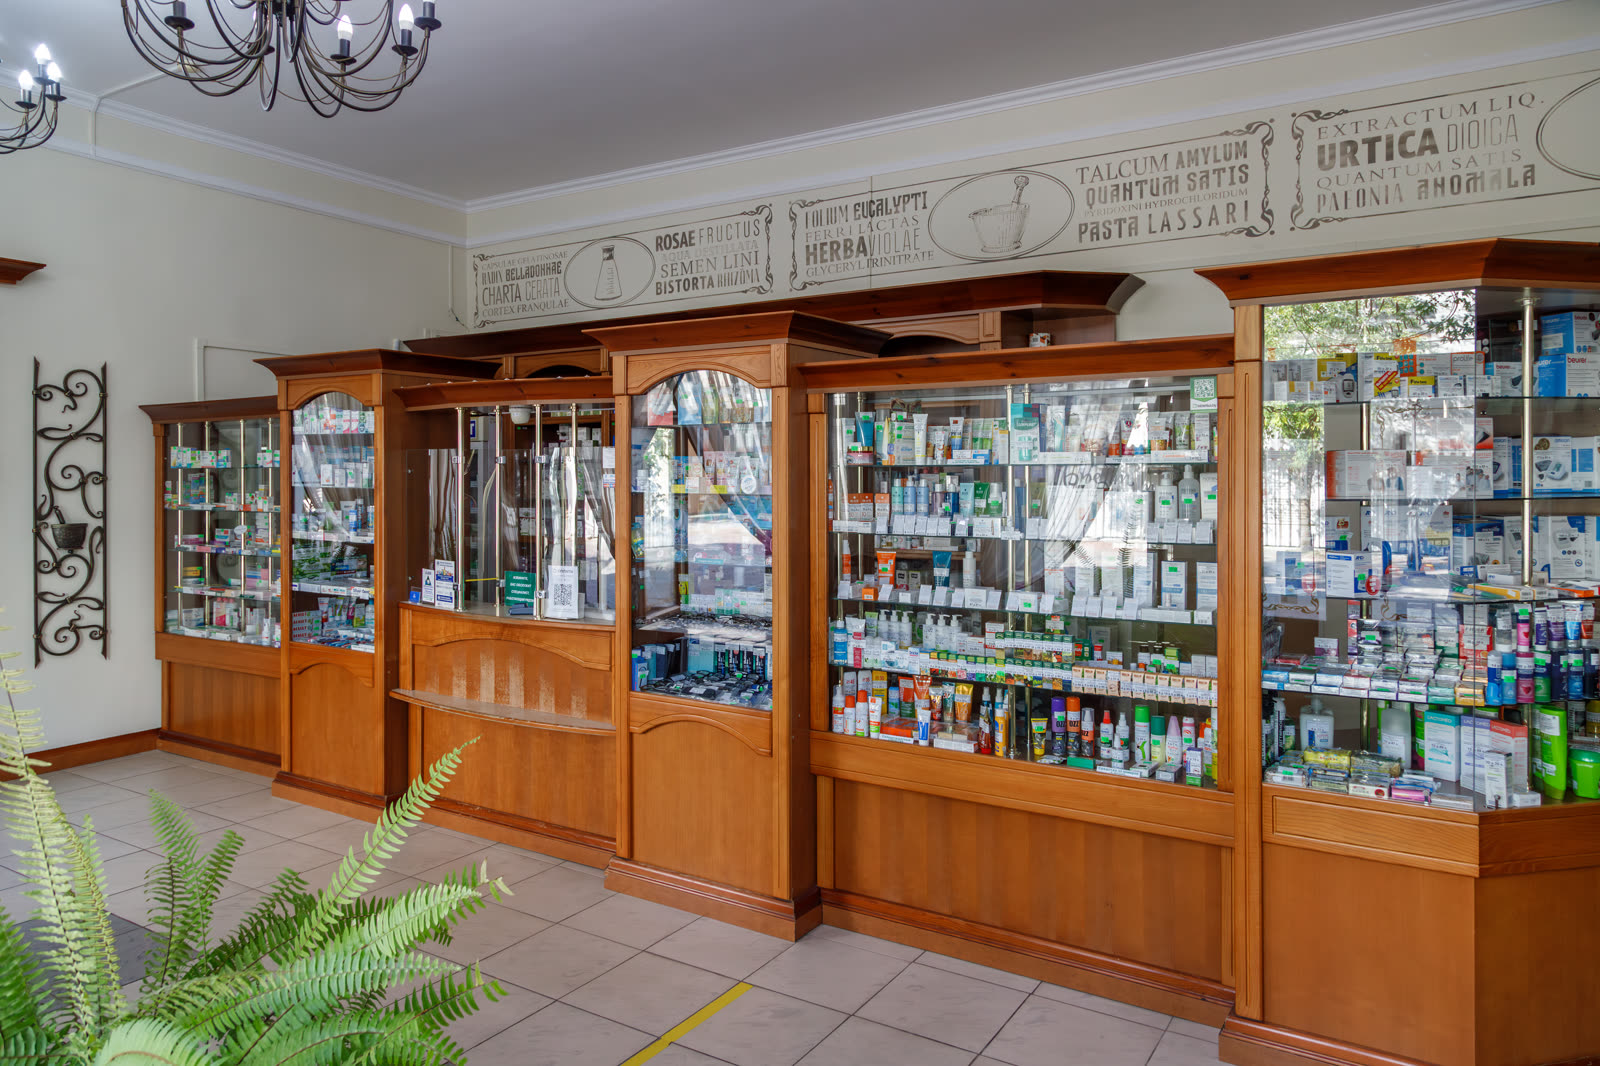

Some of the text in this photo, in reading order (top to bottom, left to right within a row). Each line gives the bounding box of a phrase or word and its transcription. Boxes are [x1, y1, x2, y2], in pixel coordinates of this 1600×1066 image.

[1317, 92, 1544, 140] EXTRACTUM LIQ.
[1317, 114, 1519, 172] URTICA DIOICA
[1076, 140, 1248, 185] TALCUM AMYLUM
[1316, 149, 1522, 190] QUANTUM SATIS
[1086, 164, 1249, 210] QUANTUM SATIS
[1417, 164, 1536, 200] ANOMALA
[853, 191, 928, 221] EUCALYPTI
[1144, 188, 1248, 209] HYDROCHLORIDUM
[656, 219, 760, 252] ROSAE FRUCTUS
[805, 214, 919, 243] FERRI LACTAS
[1078, 200, 1249, 244] PASTA LASSARI
[805, 227, 920, 266] HERBA VIOLAE
[661, 250, 760, 279] SEMEN LINI
[806, 250, 934, 278] GLYCERYL TRINITRATE
[482, 277, 560, 307] CHARTA CERATA
[655, 275, 715, 296] BISTORTA
[482, 305, 515, 318] CORTEX
[1567, 356, 1587, 364] beurer
